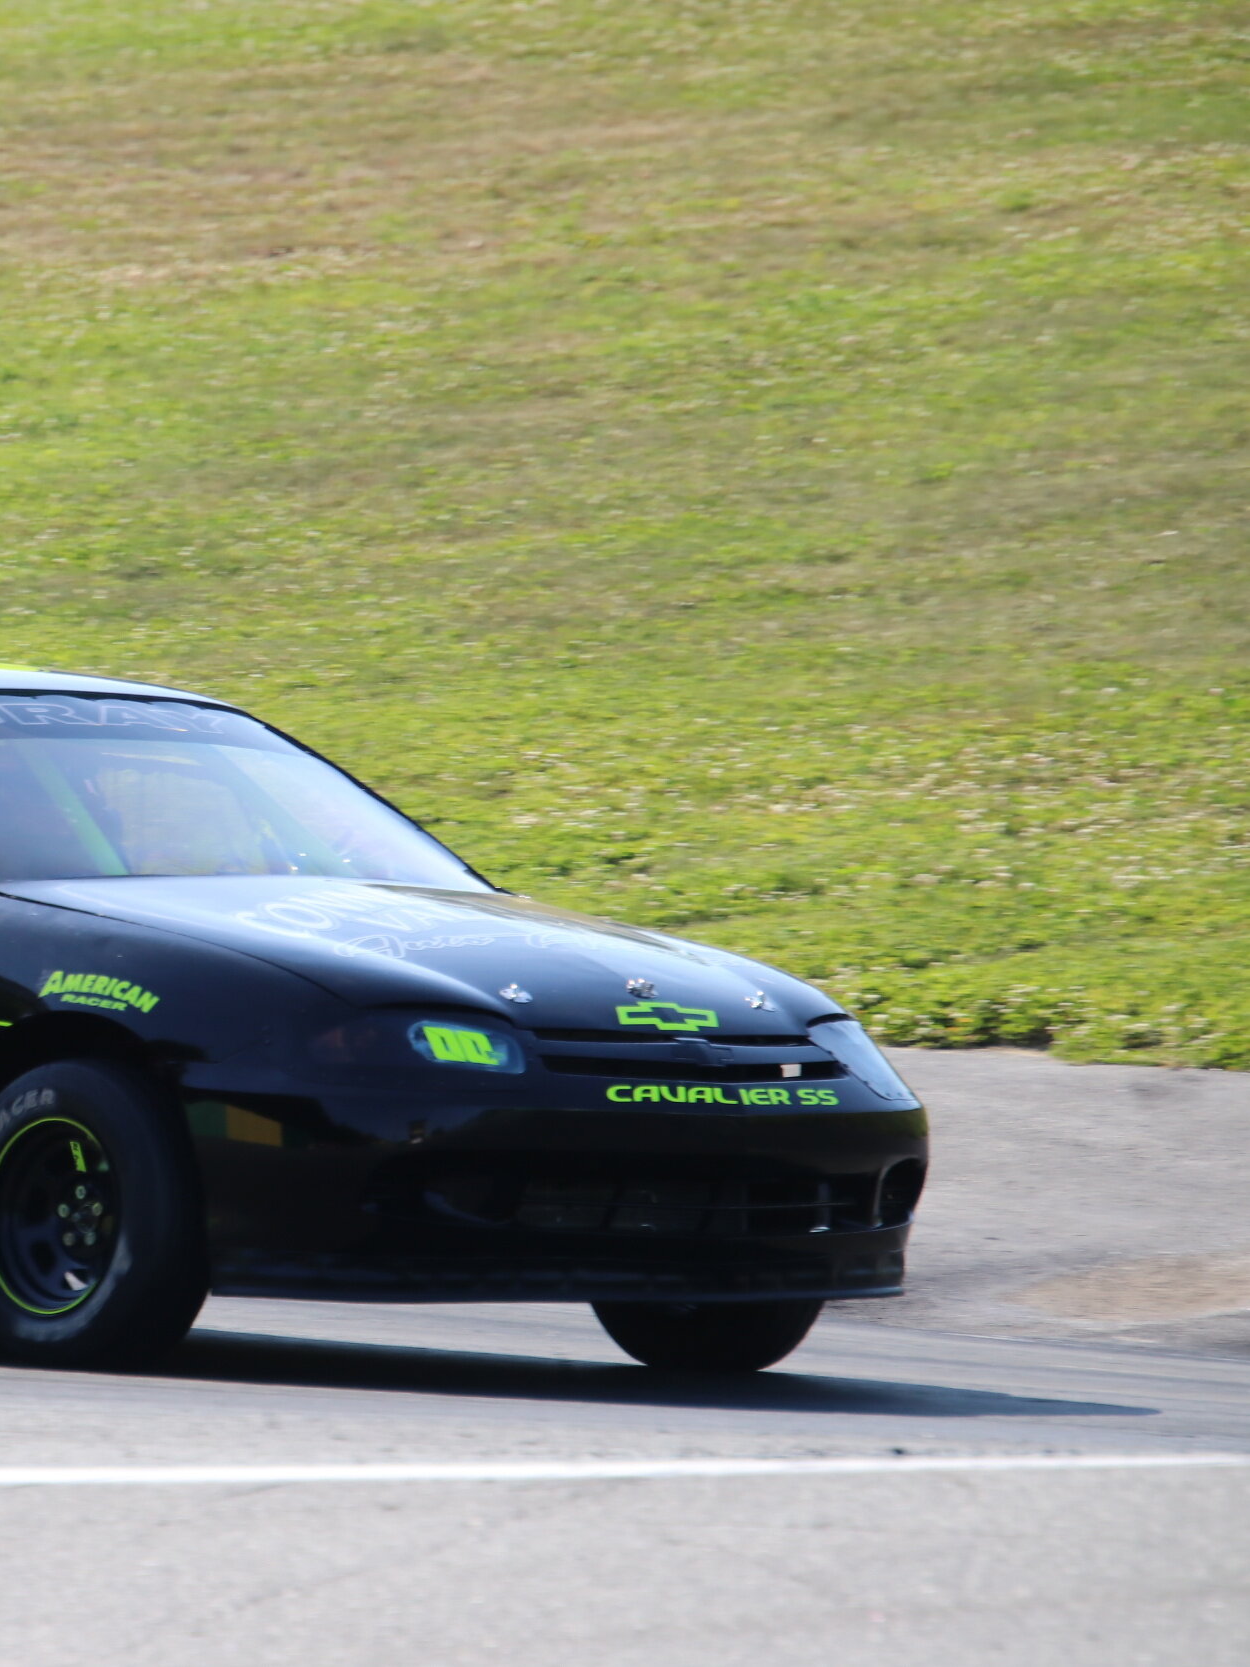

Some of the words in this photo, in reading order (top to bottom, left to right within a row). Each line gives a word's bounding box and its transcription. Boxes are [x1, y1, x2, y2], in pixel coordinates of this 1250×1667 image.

[38, 970, 160, 1013] AMERICAN
[60, 993, 128, 1011] RACER
[606, 1084, 790, 1106] CAVALIER
[796, 1088, 840, 1107] SS
